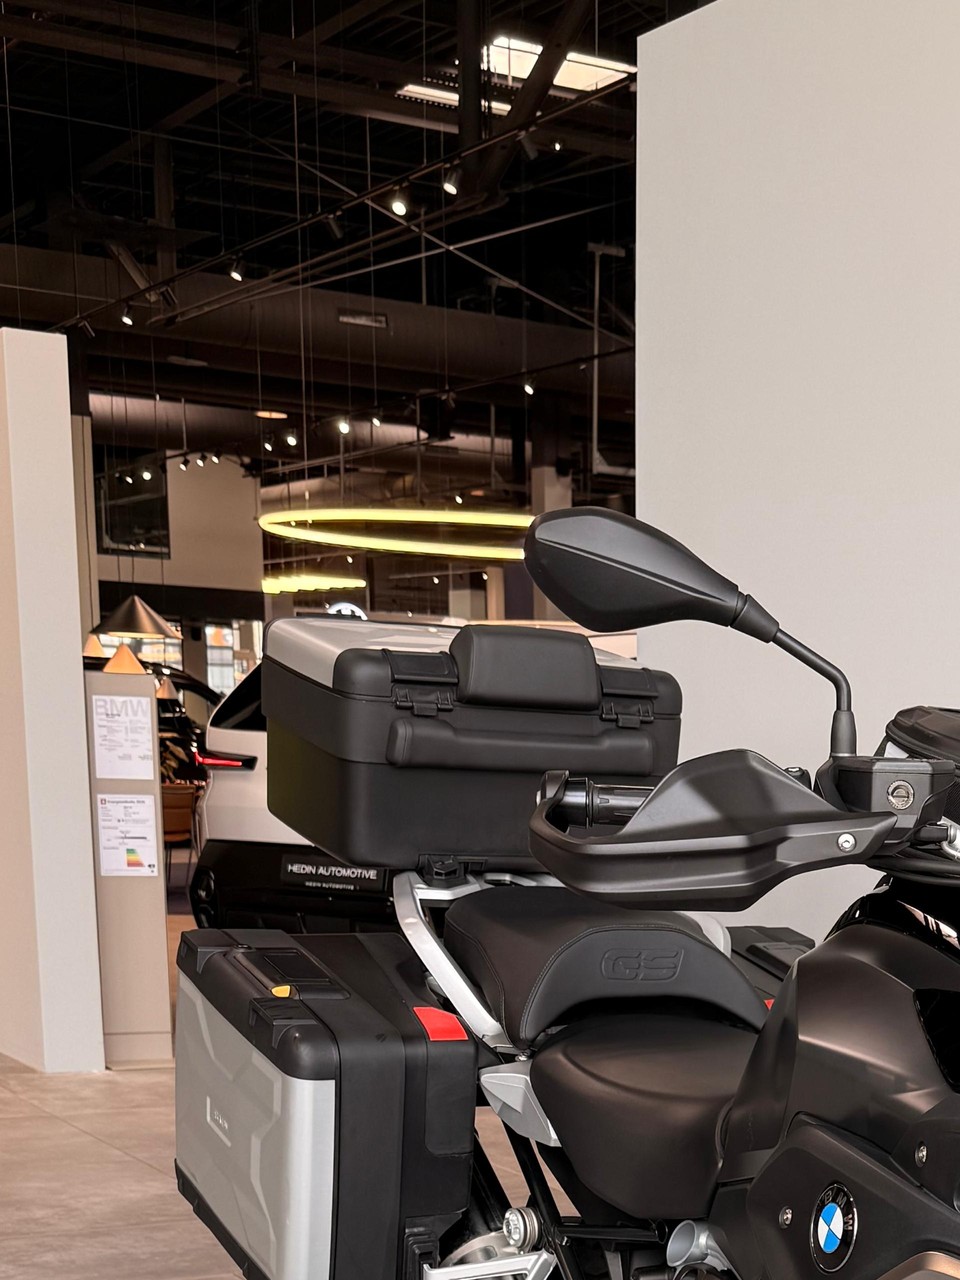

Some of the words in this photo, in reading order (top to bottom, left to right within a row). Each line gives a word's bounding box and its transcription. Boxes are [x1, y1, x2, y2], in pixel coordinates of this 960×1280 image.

[95, 698, 150, 717] BMW
[287, 864, 316, 874] HEDIN
[317, 866, 378, 880] AUTOMOTIVE
[601, 948, 684, 981] GS
[823, 1189, 854, 1231] BMW
